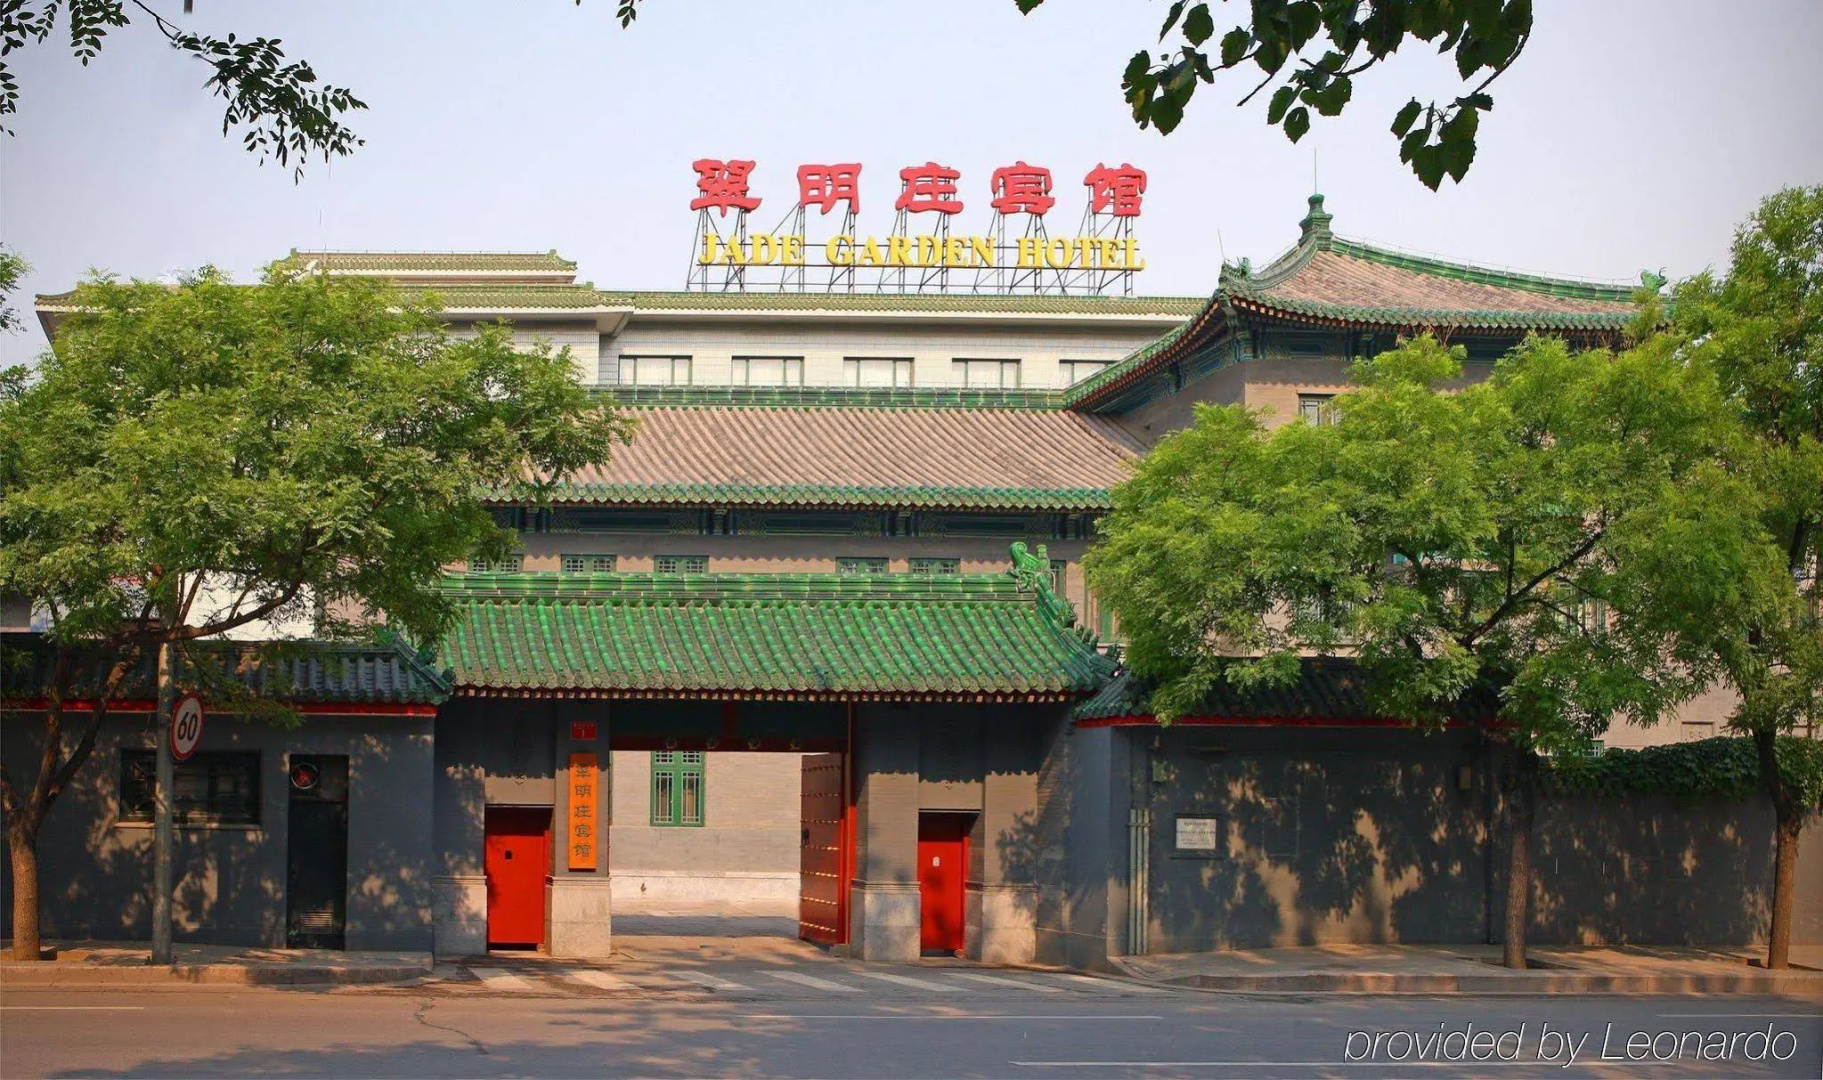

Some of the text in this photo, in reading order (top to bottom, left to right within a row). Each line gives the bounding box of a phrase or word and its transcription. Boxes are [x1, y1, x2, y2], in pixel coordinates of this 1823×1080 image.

[690, 159, 1147, 217] 翠明庄宾馆
[698, 232, 1146, 270] JADE GARDEN HOTEL
[177, 711, 199, 742] 60
